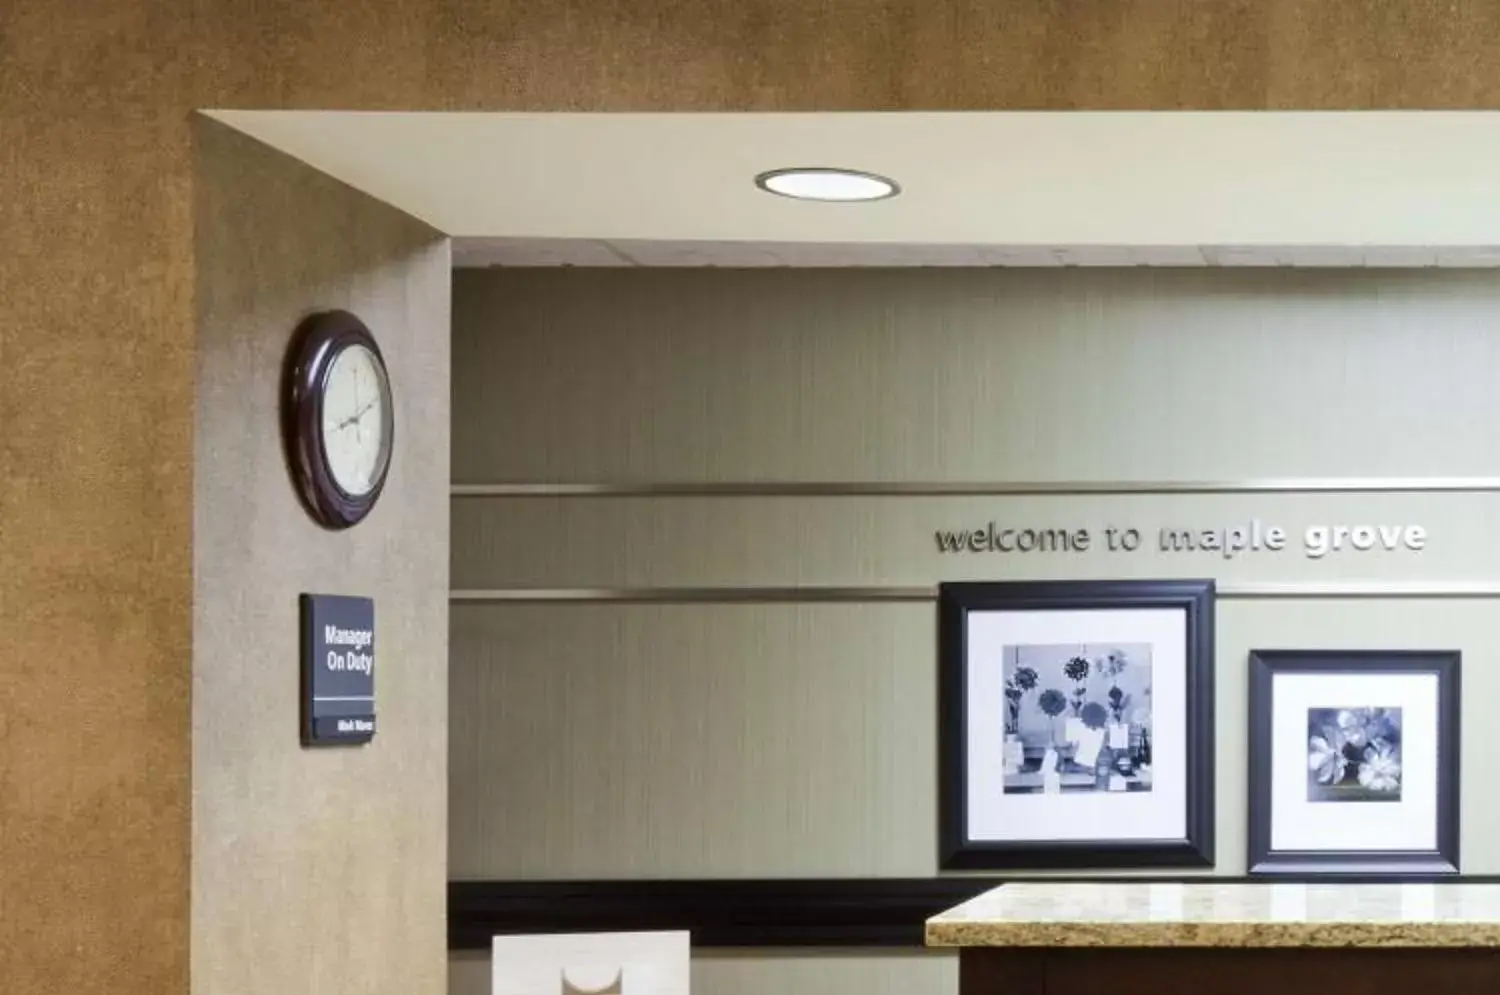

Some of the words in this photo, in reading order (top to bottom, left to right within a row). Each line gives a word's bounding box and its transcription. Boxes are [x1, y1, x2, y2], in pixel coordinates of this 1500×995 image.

[935, 521, 1090, 552] welcome
[1105, 524, 1141, 552] to
[1159, 520, 1287, 559] maple
[1304, 522, 1428, 558] grove
[325, 624, 372, 650] Manager
[327, 651, 345, 671] On
[347, 651, 373, 676] Duty
